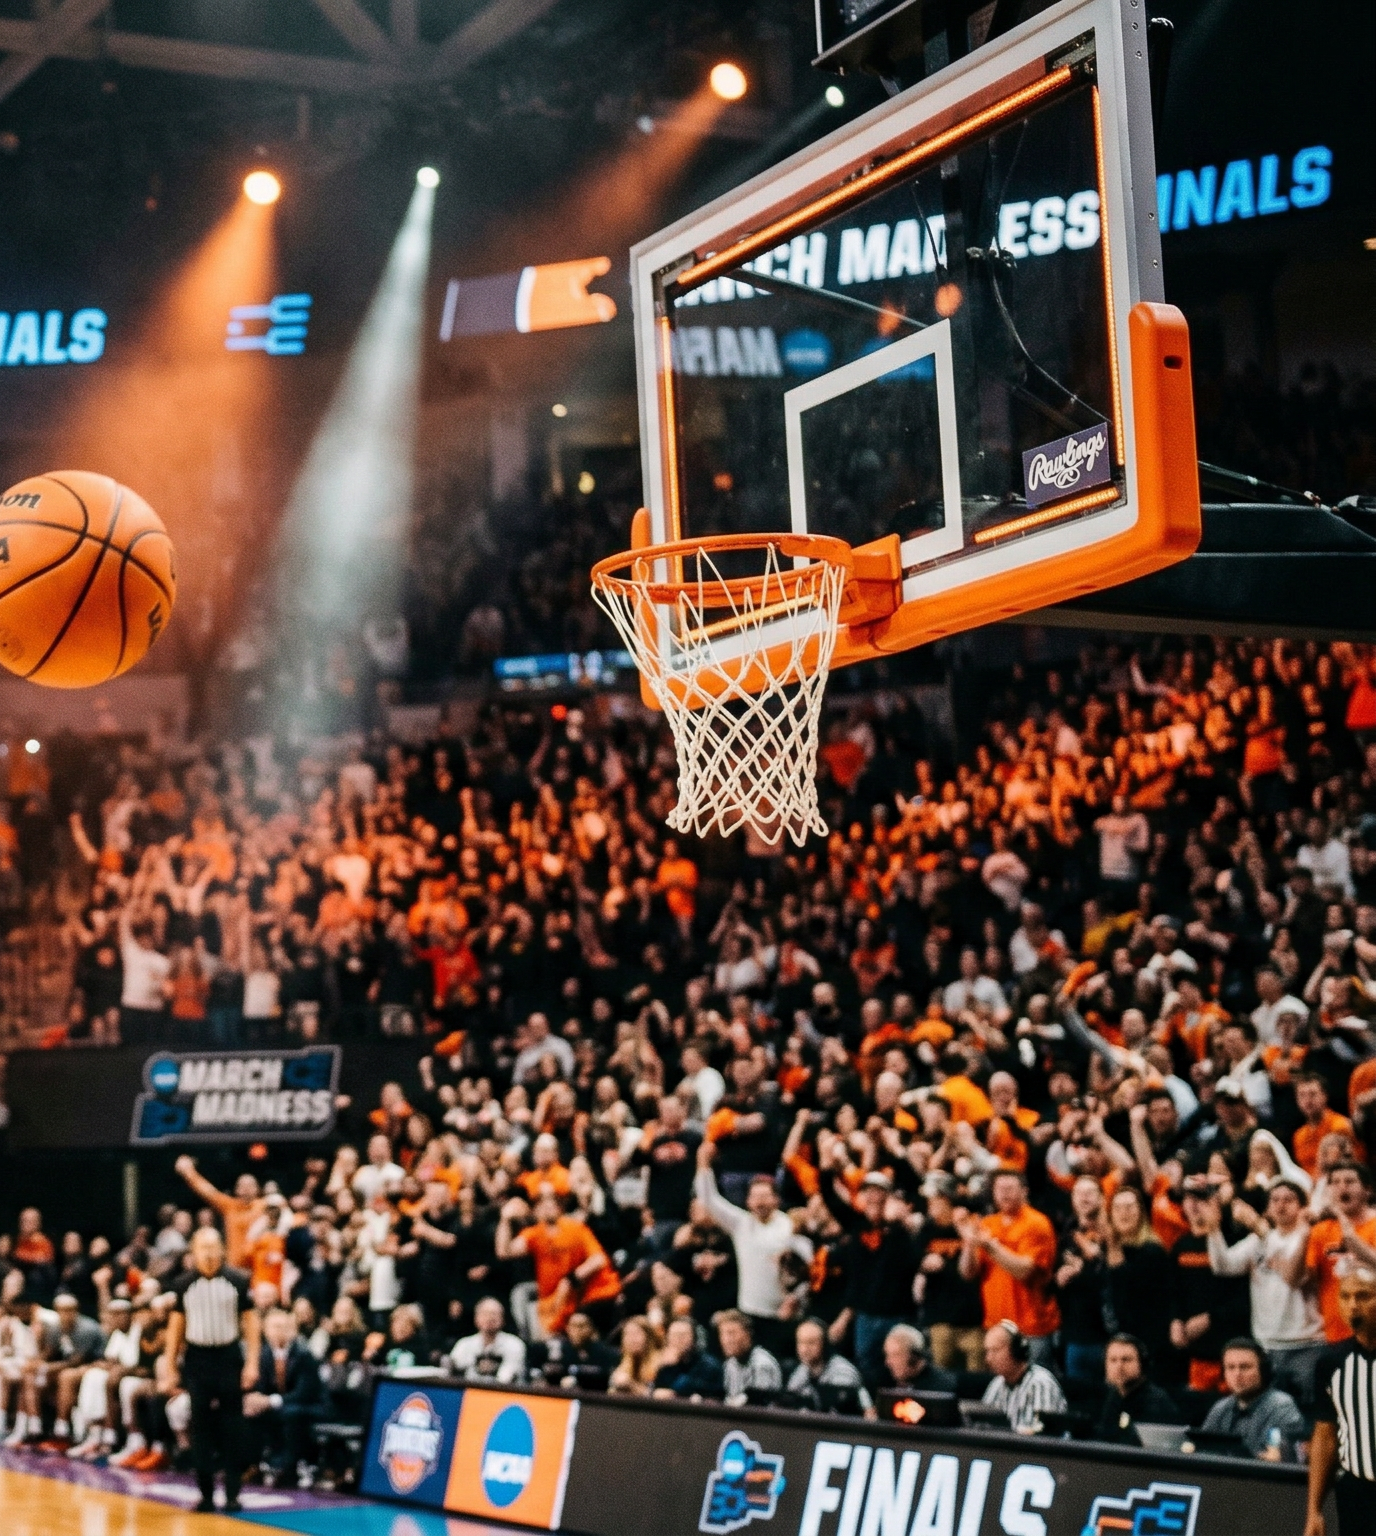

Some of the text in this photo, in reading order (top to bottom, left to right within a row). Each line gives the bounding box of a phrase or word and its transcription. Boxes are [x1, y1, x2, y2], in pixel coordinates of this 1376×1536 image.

[837, 190, 1100, 286] MADESS
[1156, 145, 1333, 234] INALS
[1028, 431, 1106, 491] Rawlings
[178, 1058, 283, 1092] MARCH
[191, 1089, 332, 1125] MADNESS
